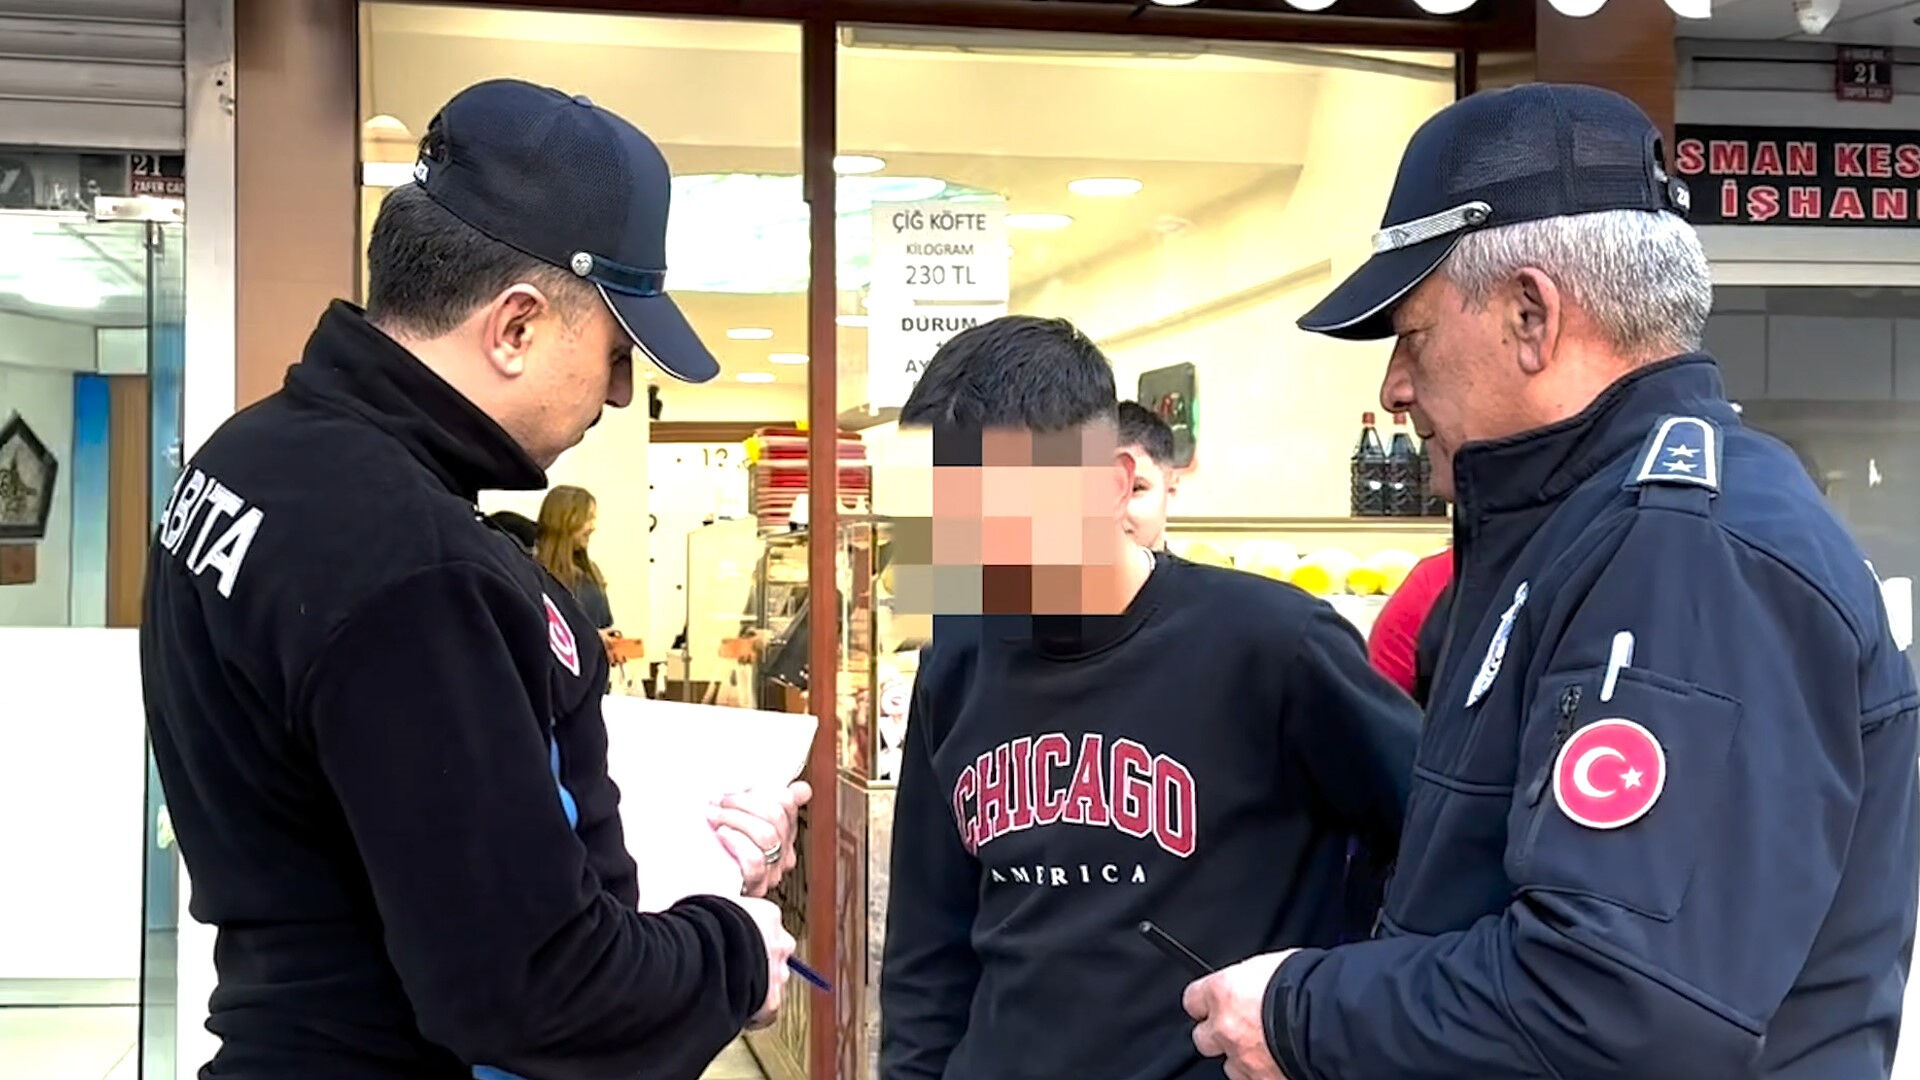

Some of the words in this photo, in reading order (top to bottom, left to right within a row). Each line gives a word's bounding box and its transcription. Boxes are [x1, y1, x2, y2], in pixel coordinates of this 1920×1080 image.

[1854, 62, 1877, 83] 21
[132, 154, 162, 176] 21
[1721, 178, 1920, 221] İŞHAN
[892, 209, 924, 233] ÇİĞ
[929, 209, 987, 231] KÖFTE
[905, 265, 945, 285] 230
[951, 265, 976, 285] TL
[953, 733, 1196, 858] CHICAGO
[991, 864, 1146, 887] AMERICA
